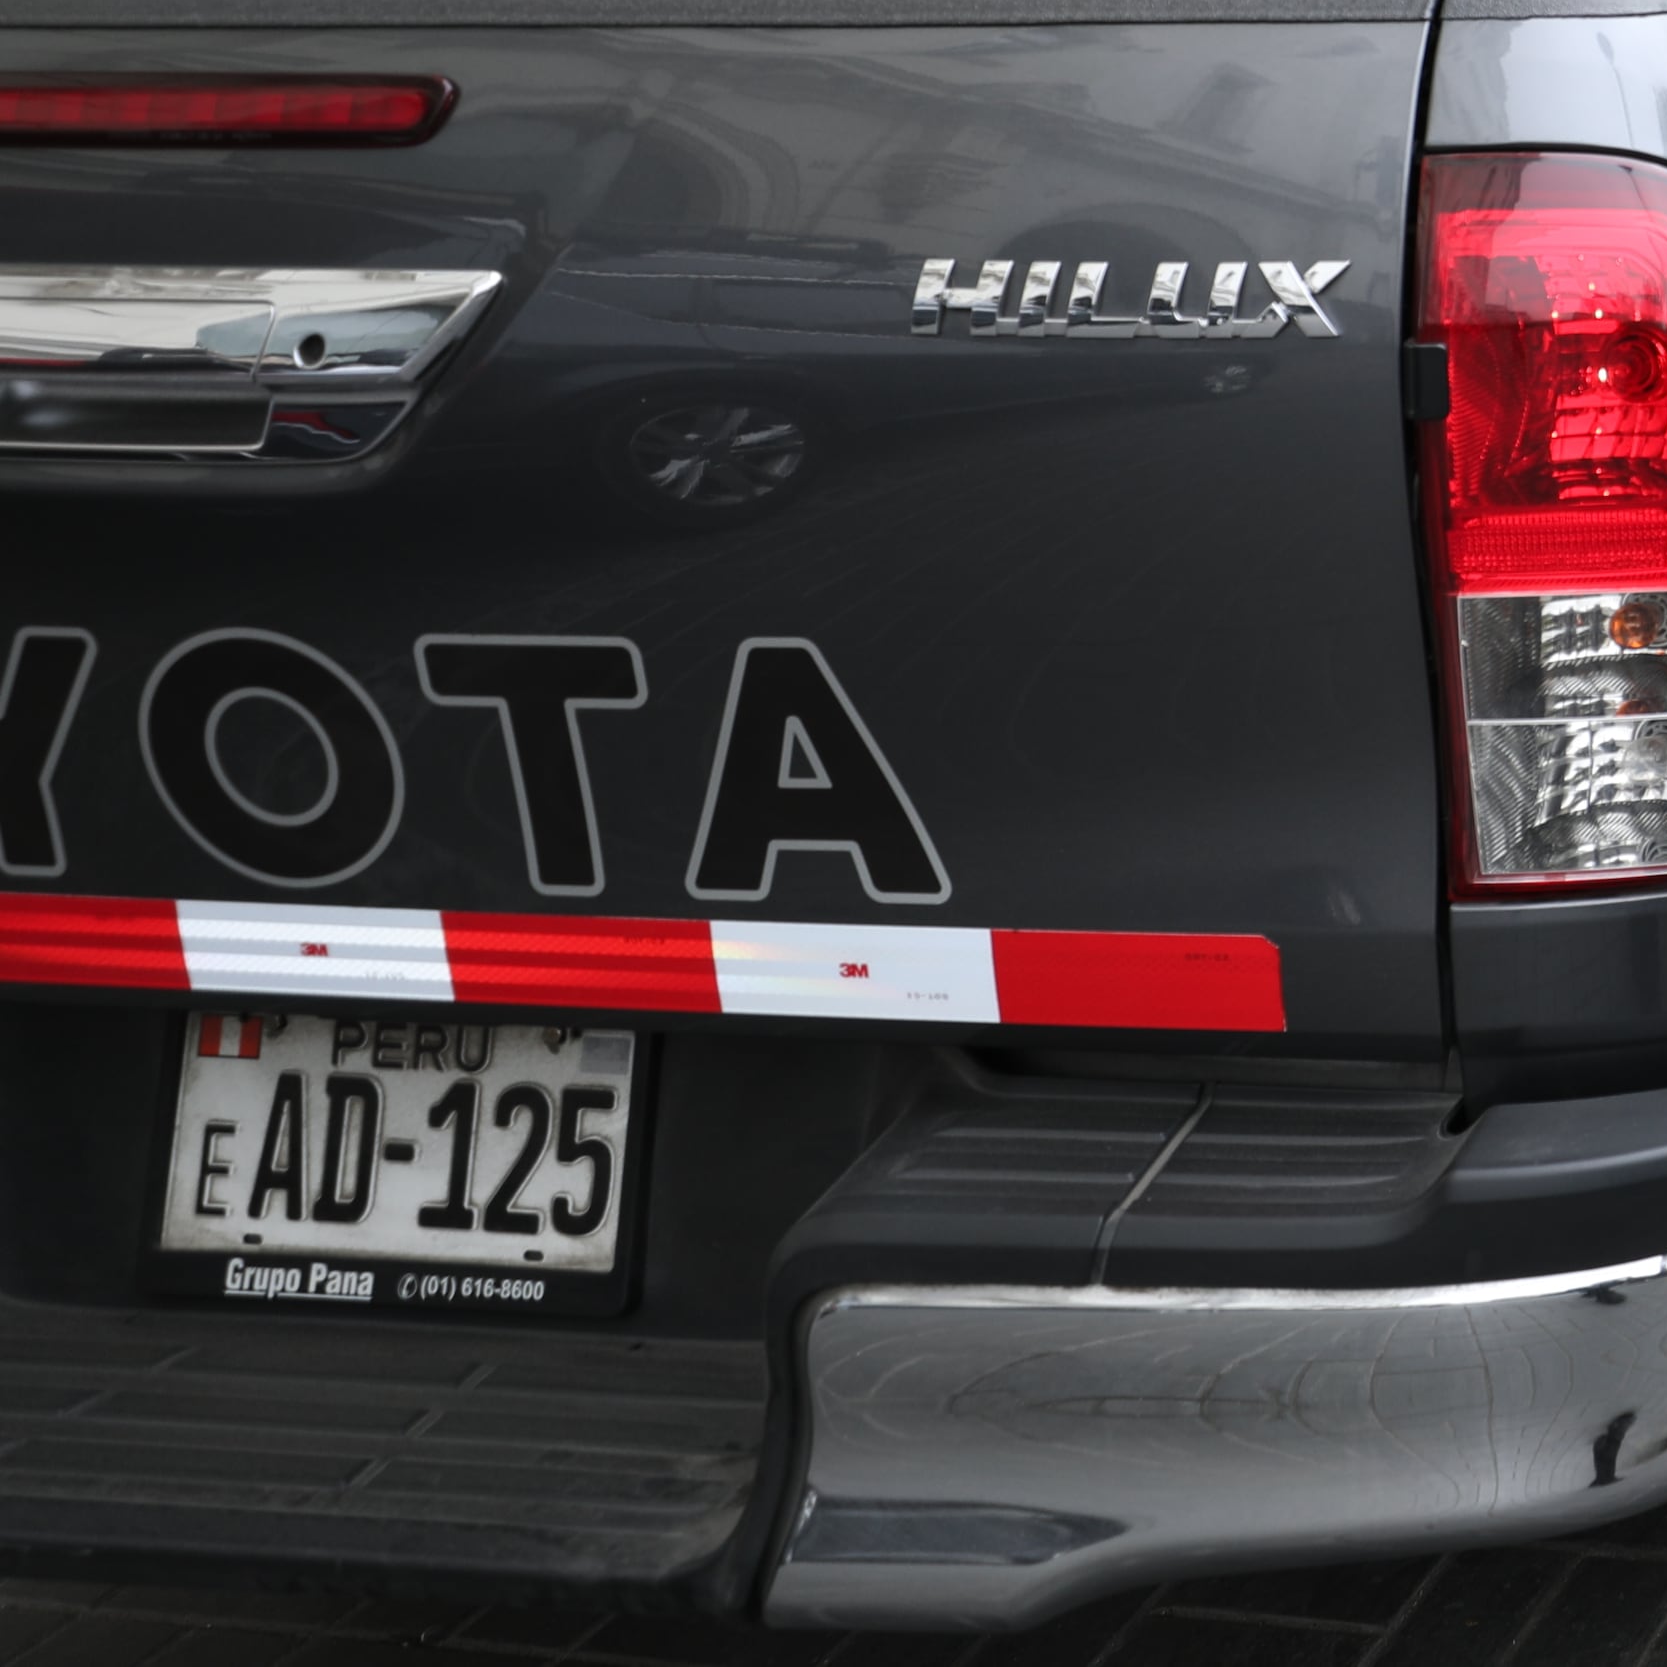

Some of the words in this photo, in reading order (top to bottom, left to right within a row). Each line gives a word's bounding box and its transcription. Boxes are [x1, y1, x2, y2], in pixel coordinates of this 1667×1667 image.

[911, 259, 1351, 337] HILUX
[300, 942, 329, 957] 3M
[839, 962, 869, 979] 3M
[331, 1020, 494, 1073] PERU
[225, 1257, 301, 1299] Grupo
[308, 1262, 374, 1296] Pana
[420, 1275, 456, 1301] (01)
[461, 1277, 545, 1301] 616-8600
